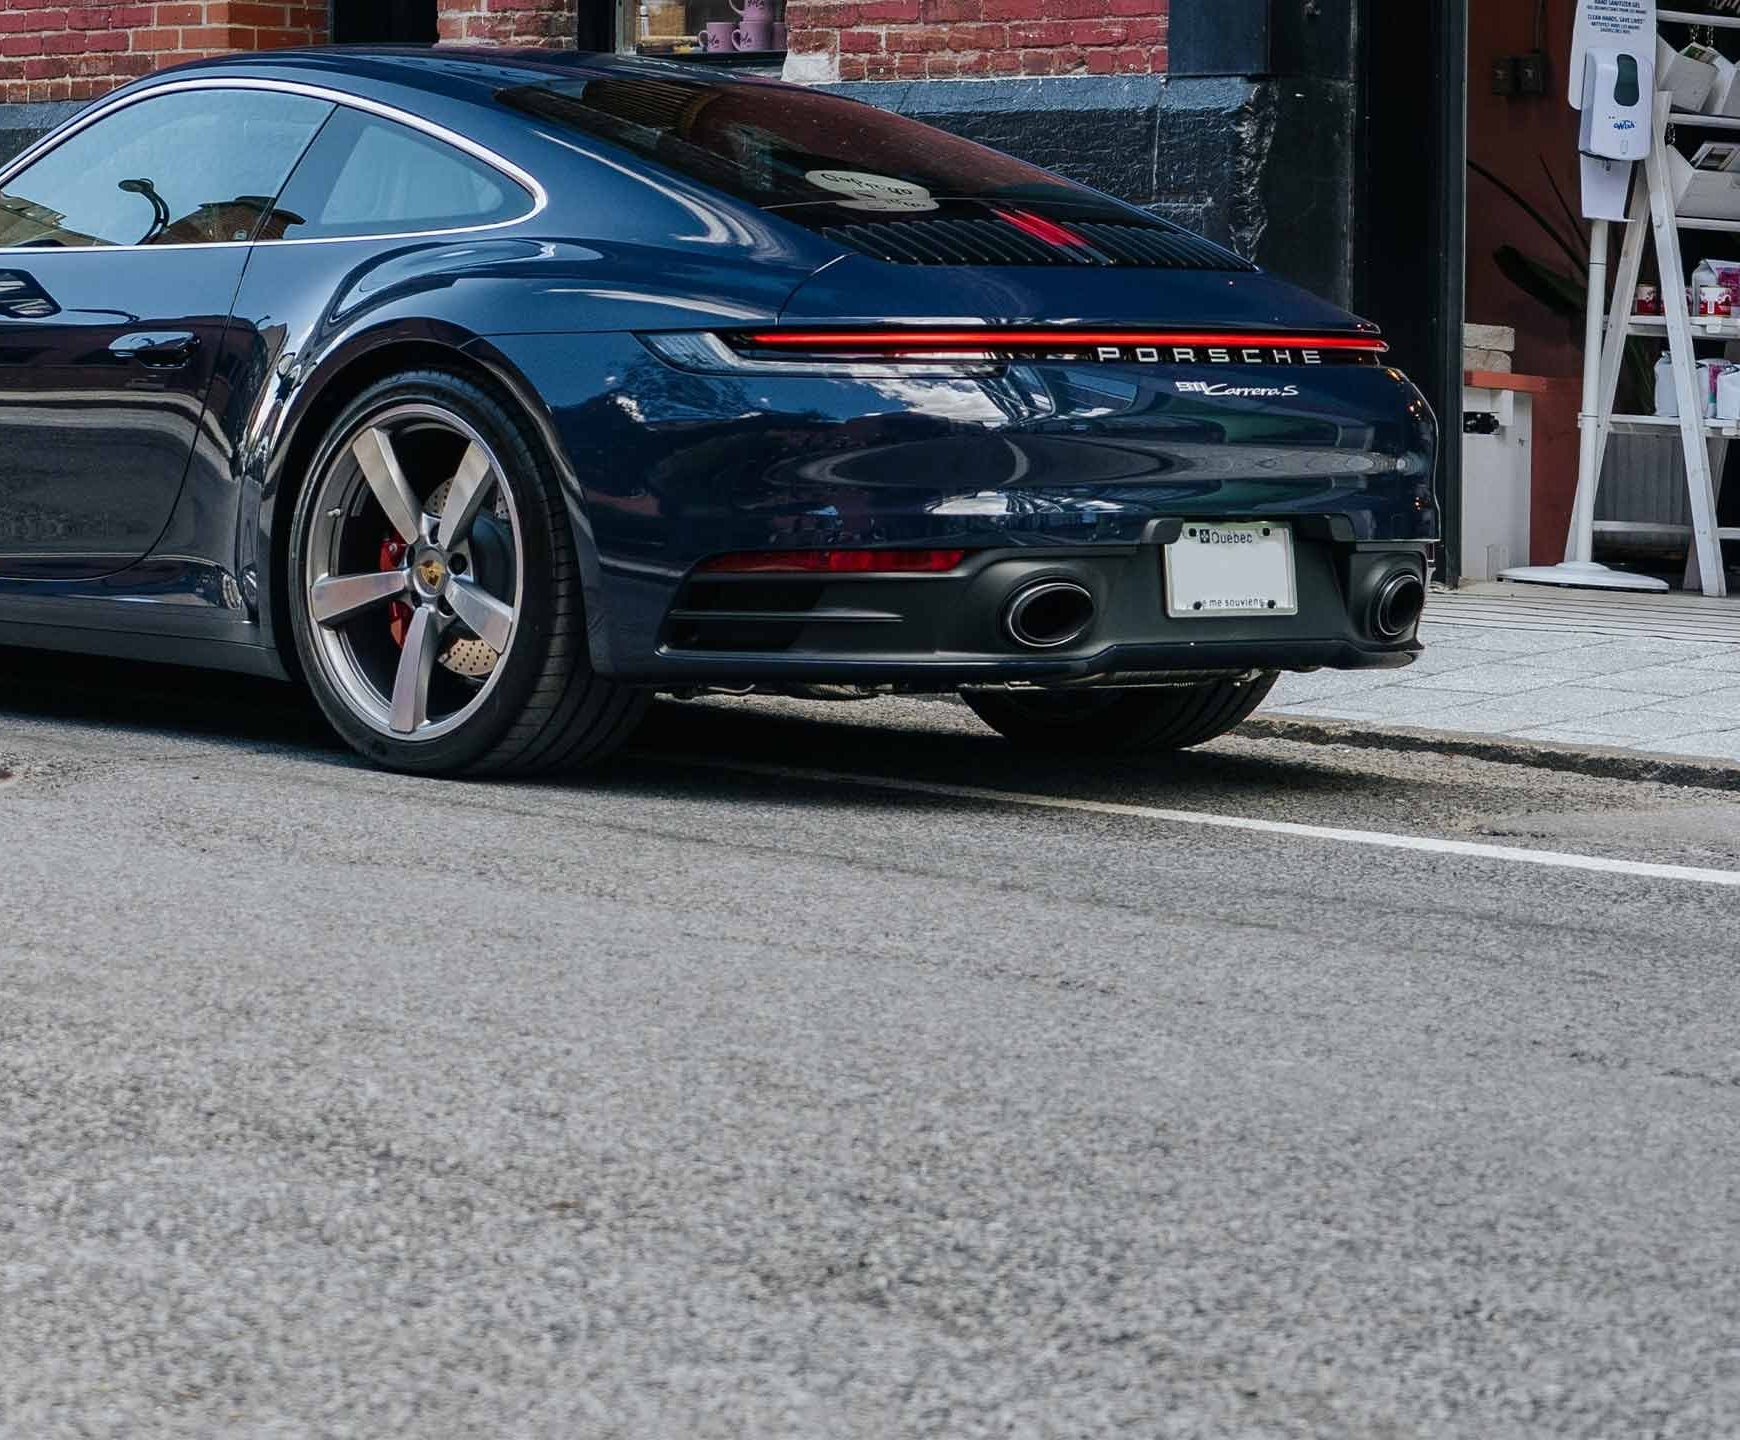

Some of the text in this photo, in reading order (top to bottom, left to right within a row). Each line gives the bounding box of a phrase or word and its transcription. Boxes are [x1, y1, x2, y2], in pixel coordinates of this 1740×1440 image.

[1097, 347, 1322, 364] PORSCHE
[1205, 383, 1278, 397] Carrera
[1281, 385, 1299, 397] S
